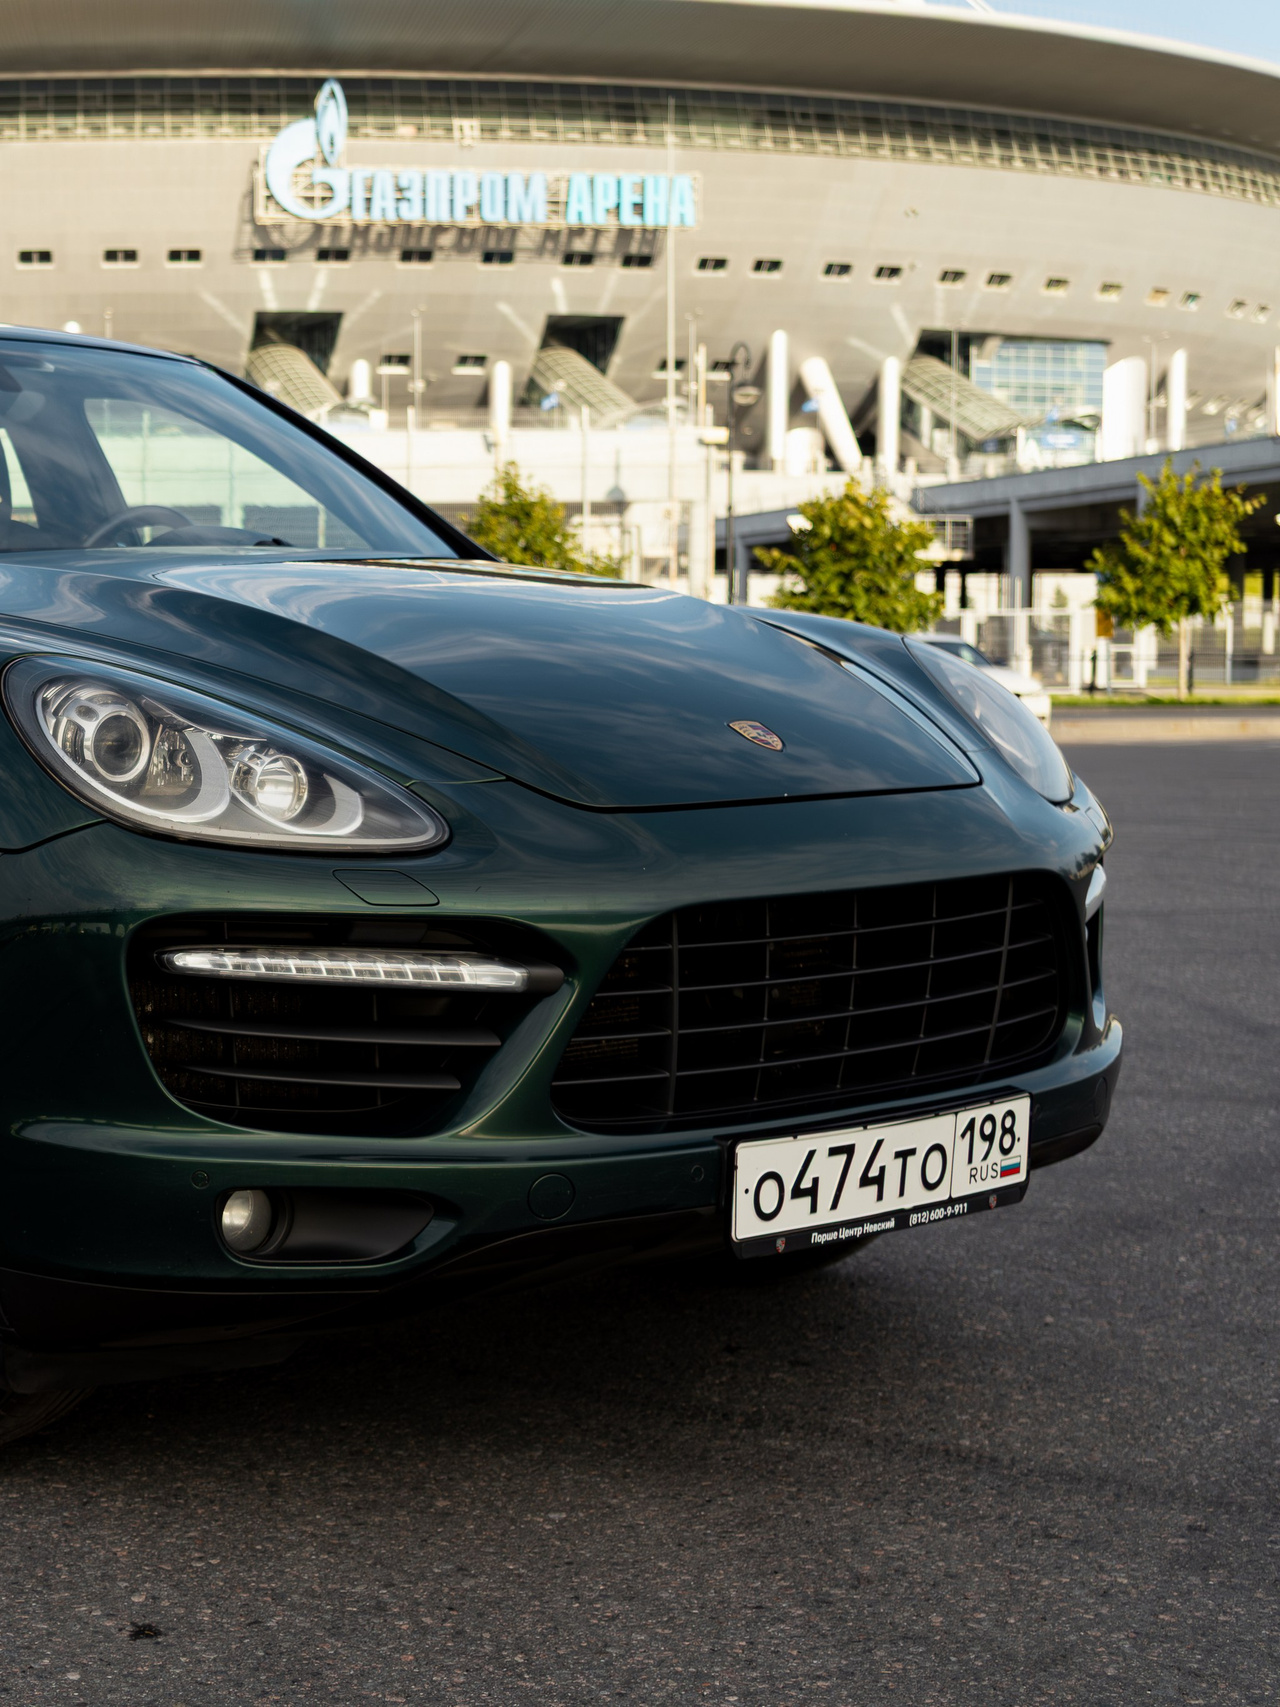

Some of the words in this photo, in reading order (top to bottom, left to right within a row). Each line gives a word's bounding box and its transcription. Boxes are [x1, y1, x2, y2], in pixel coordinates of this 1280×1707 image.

[351, 168, 549, 224] ГАЗПРОМ
[565, 172, 696, 227] АРЕНА
[959, 1109, 1017, 1166] 198
[968, 1161, 1000, 1185] RUS
[811, 1231, 838, 1244] Порше
[838, 1226, 862, 1240] Центр
[863, 1217, 895, 1234] Невский
[909, 1212, 929, 1227] (812)
[929, 1202, 968, 1222] 600-9-911
